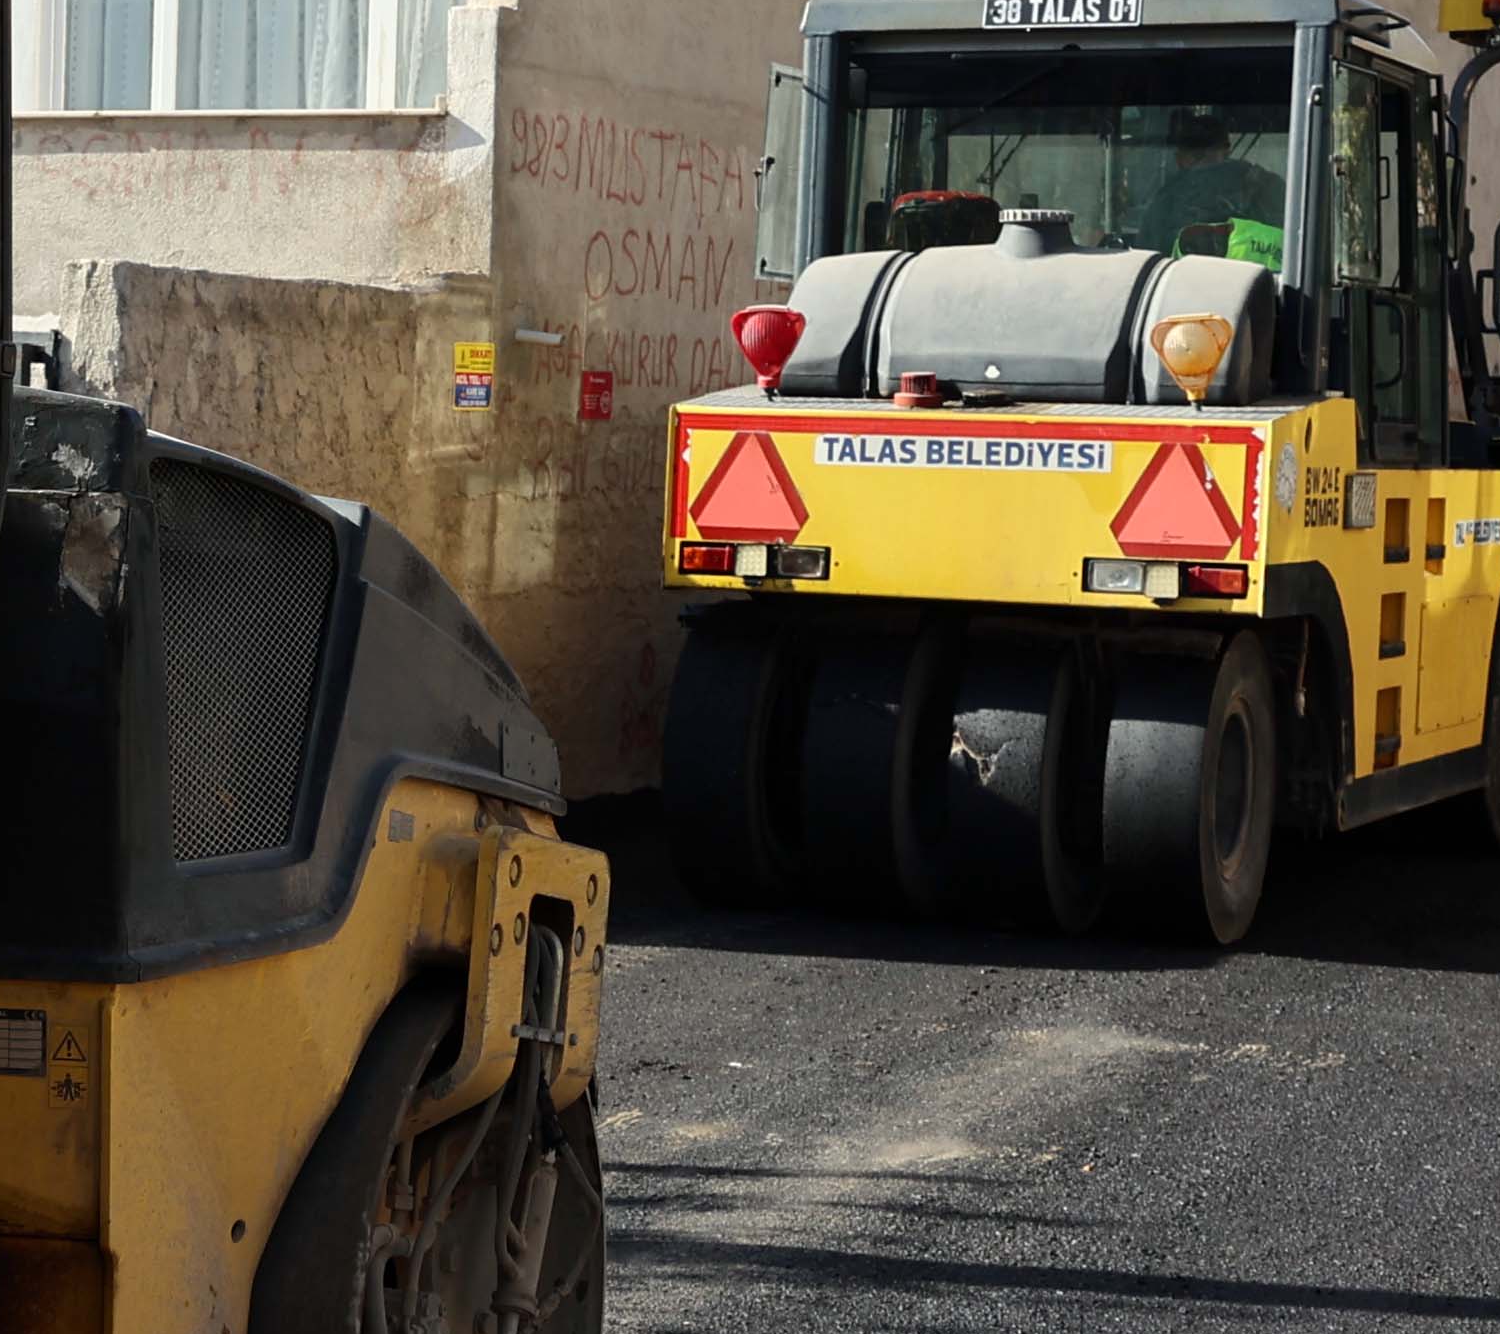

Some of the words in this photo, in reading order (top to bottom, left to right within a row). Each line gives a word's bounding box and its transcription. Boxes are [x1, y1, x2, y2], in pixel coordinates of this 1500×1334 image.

[584, 229, 734, 312] OSMAN
[823, 437, 917, 464] TALAS
[1304, 497, 1339, 528] BOMAG
